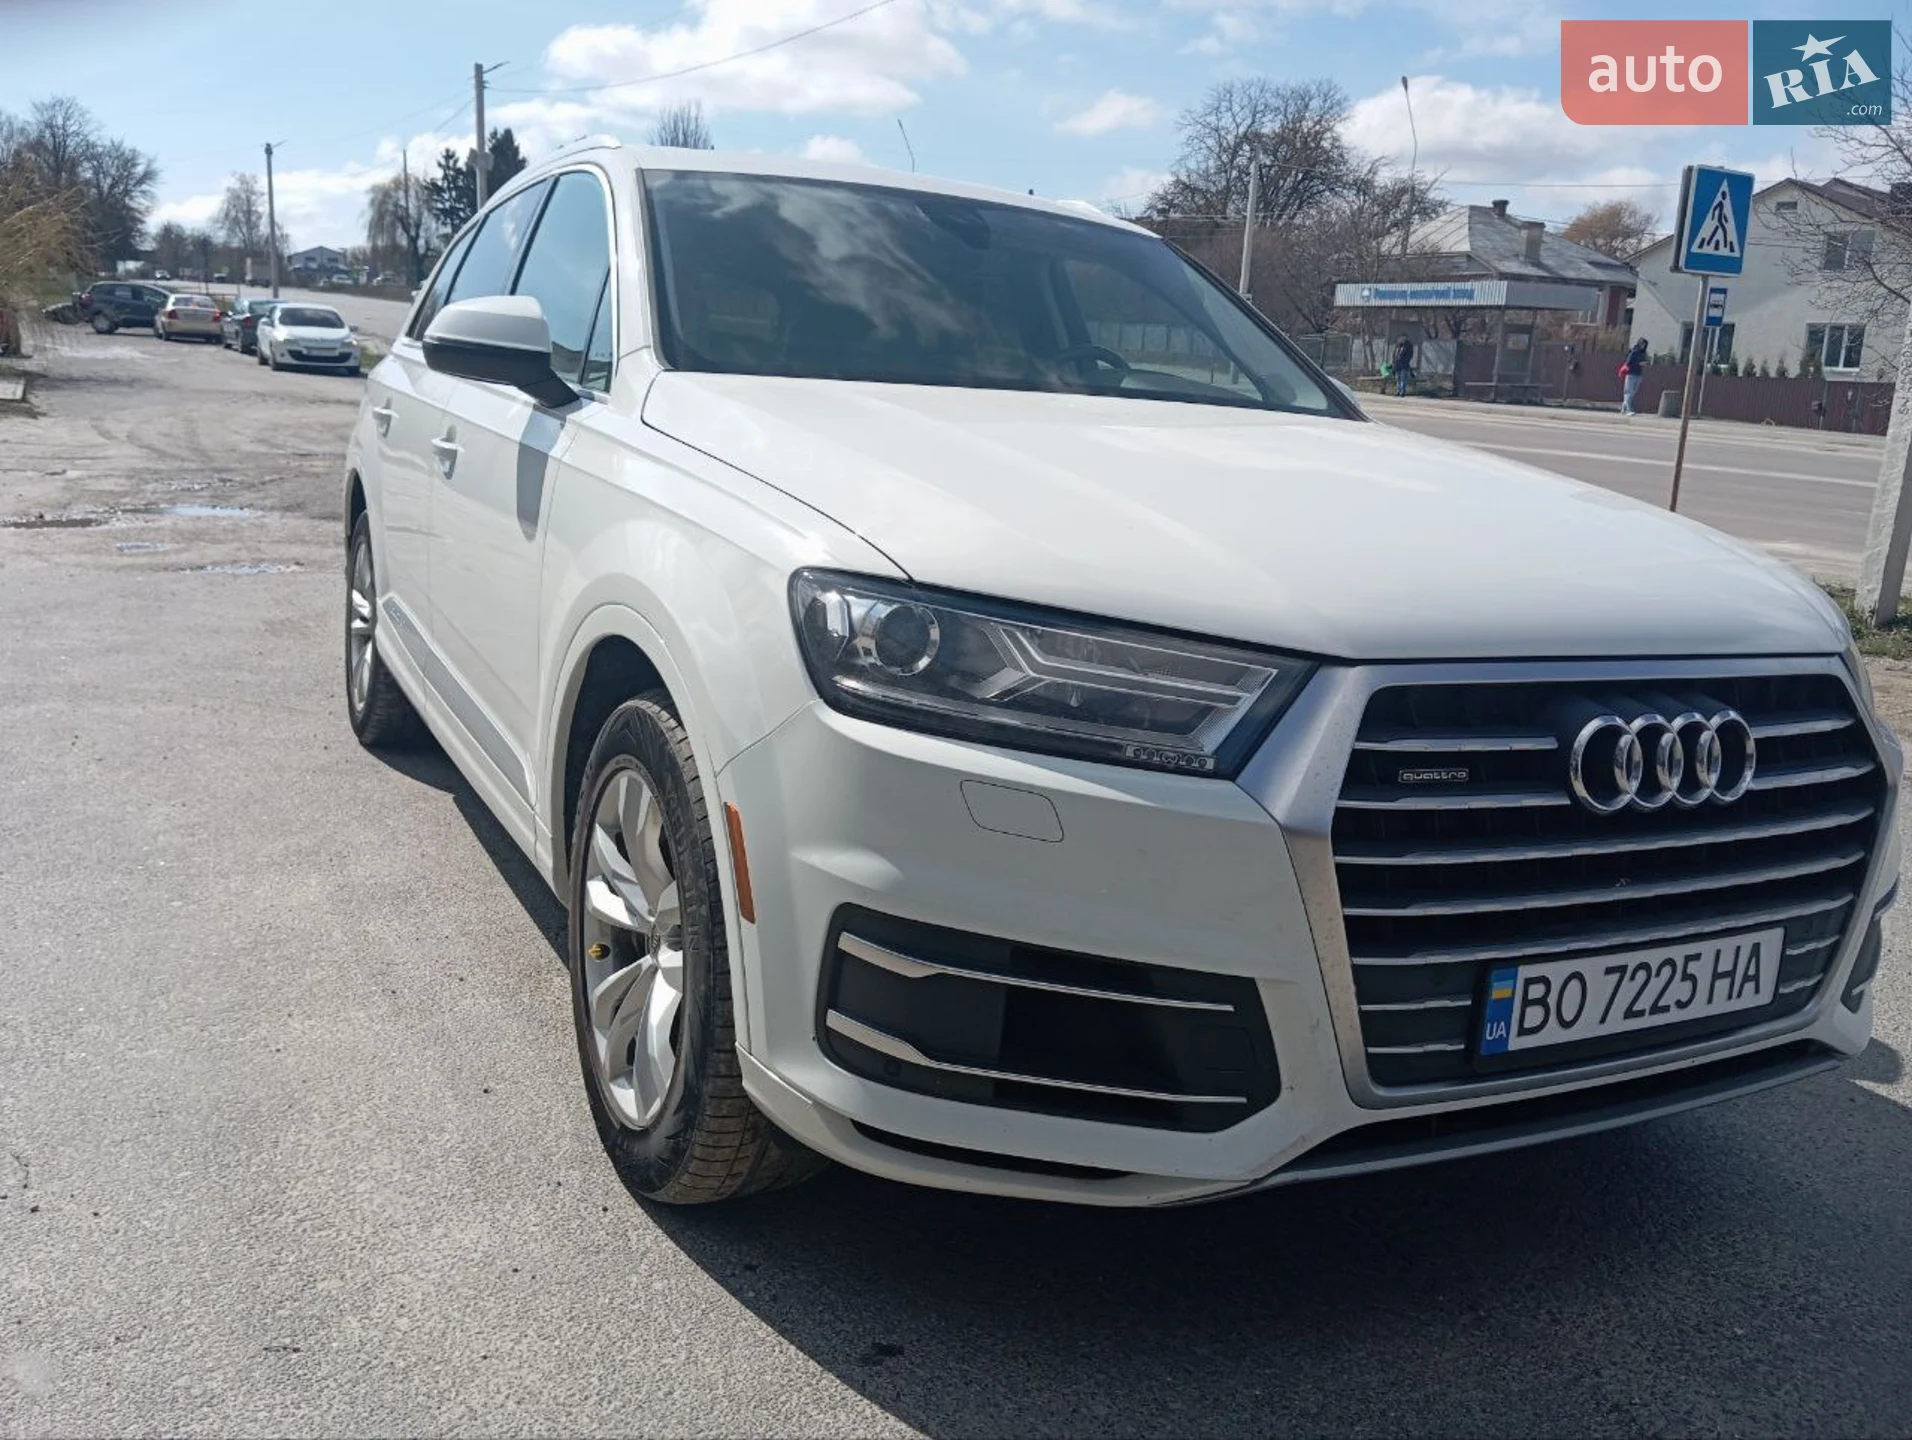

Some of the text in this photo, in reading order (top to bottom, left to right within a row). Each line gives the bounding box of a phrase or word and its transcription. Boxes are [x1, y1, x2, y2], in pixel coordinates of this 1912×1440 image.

[1402, 770, 1467, 781] quattro
[1516, 941, 1762, 1038] BO 7225 HA
[1485, 1022, 1507, 1041] UA
